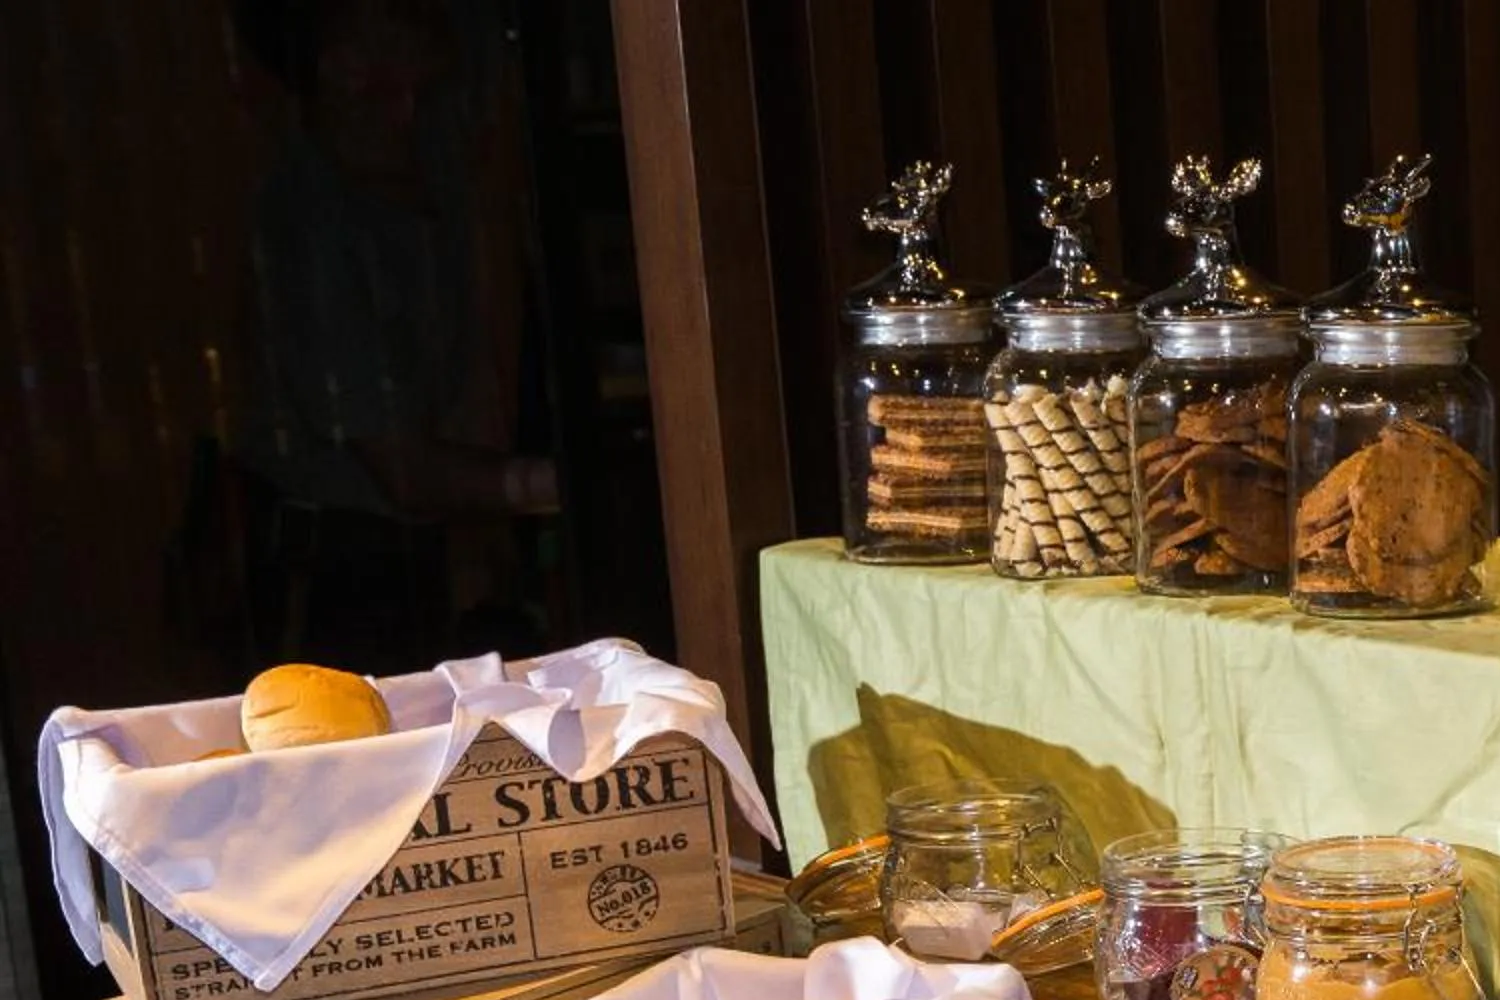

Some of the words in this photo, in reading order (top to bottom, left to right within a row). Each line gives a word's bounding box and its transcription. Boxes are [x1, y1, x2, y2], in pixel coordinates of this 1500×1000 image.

[494, 757, 695, 828] STORE
[550, 845, 603, 869] EST
[620, 832, 689, 859] 1846
[355, 911, 515, 951] SELECTED
[312, 955, 383, 977] FROM
[392, 945, 442, 963] THE
[450, 933, 516, 955] FARM
